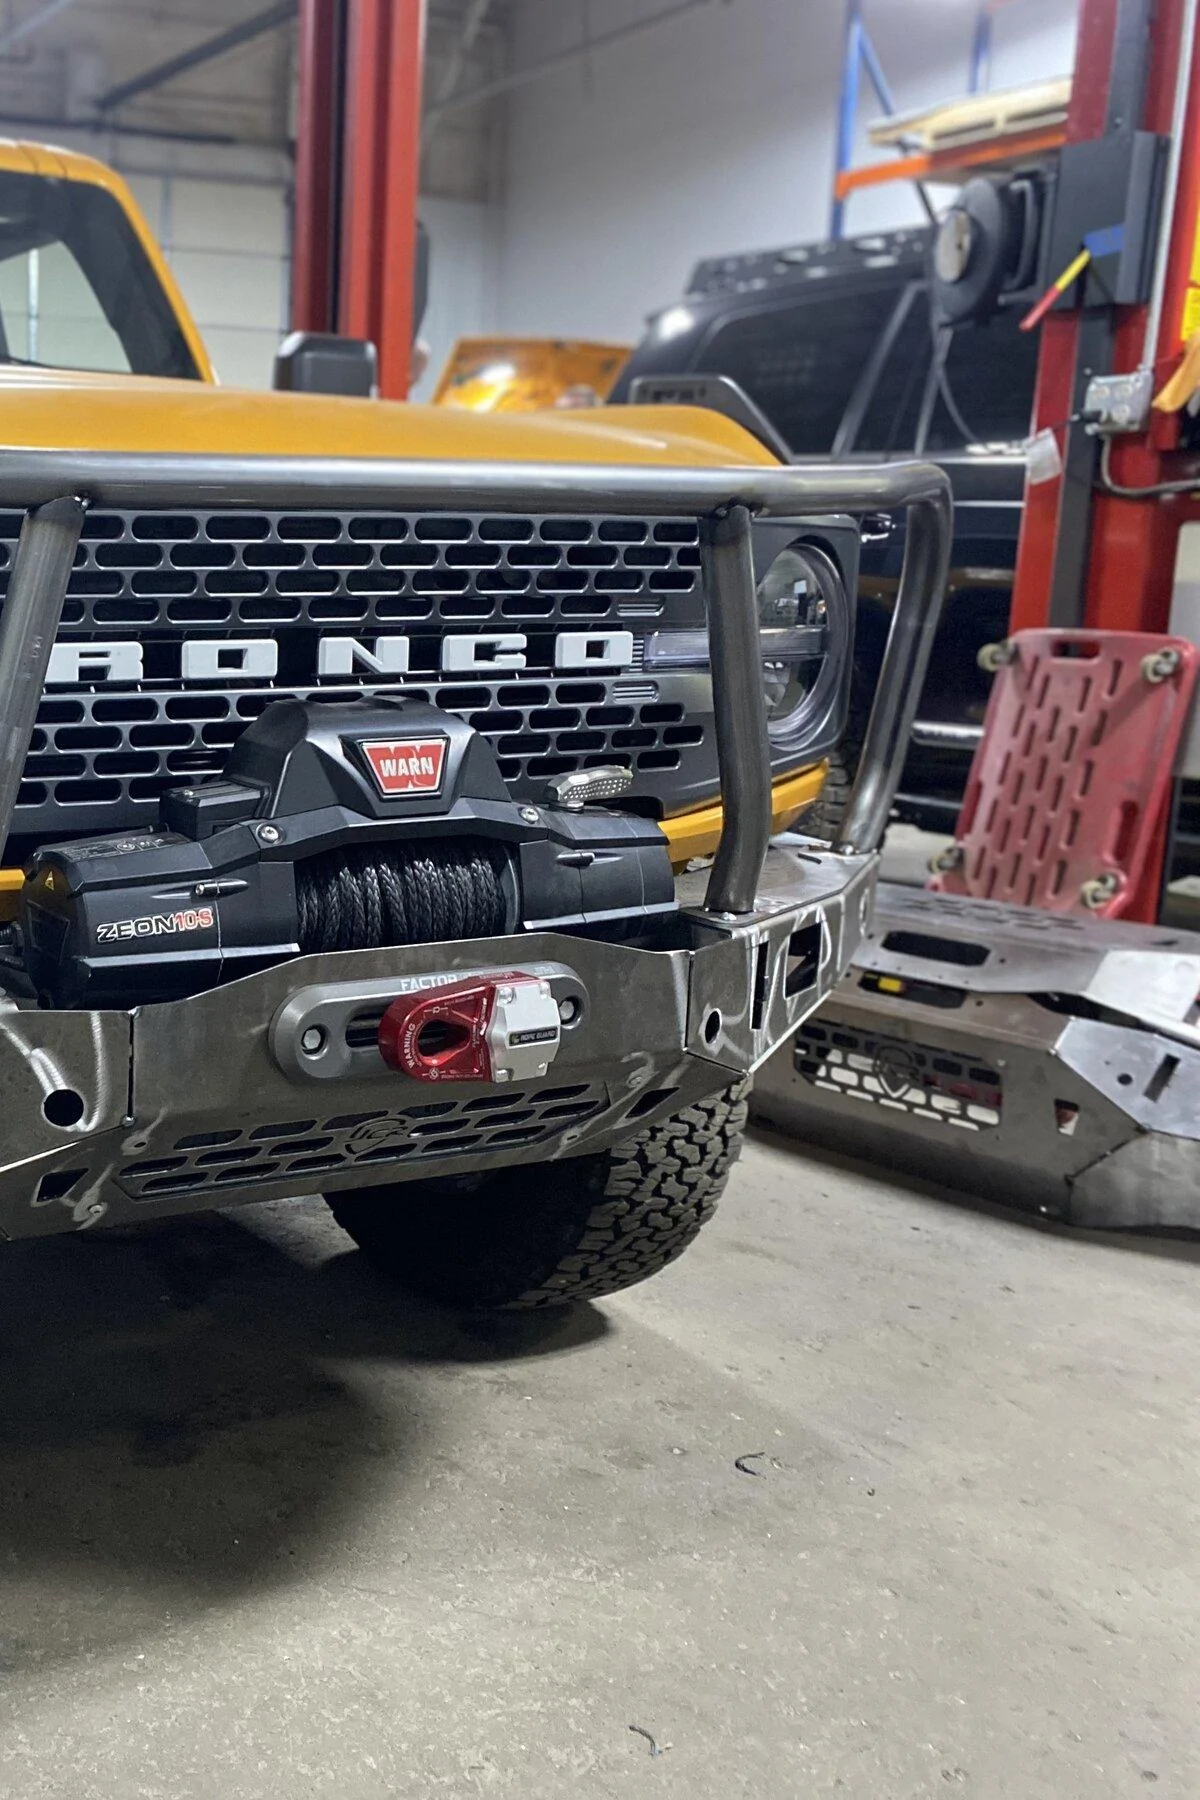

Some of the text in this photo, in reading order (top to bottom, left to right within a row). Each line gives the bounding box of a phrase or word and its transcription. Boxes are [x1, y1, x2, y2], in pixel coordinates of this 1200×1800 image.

[380, 756, 435, 778] WARN
[400, 974, 458, 992] FACTOR
[403, 1022, 416, 1069] WARNING
